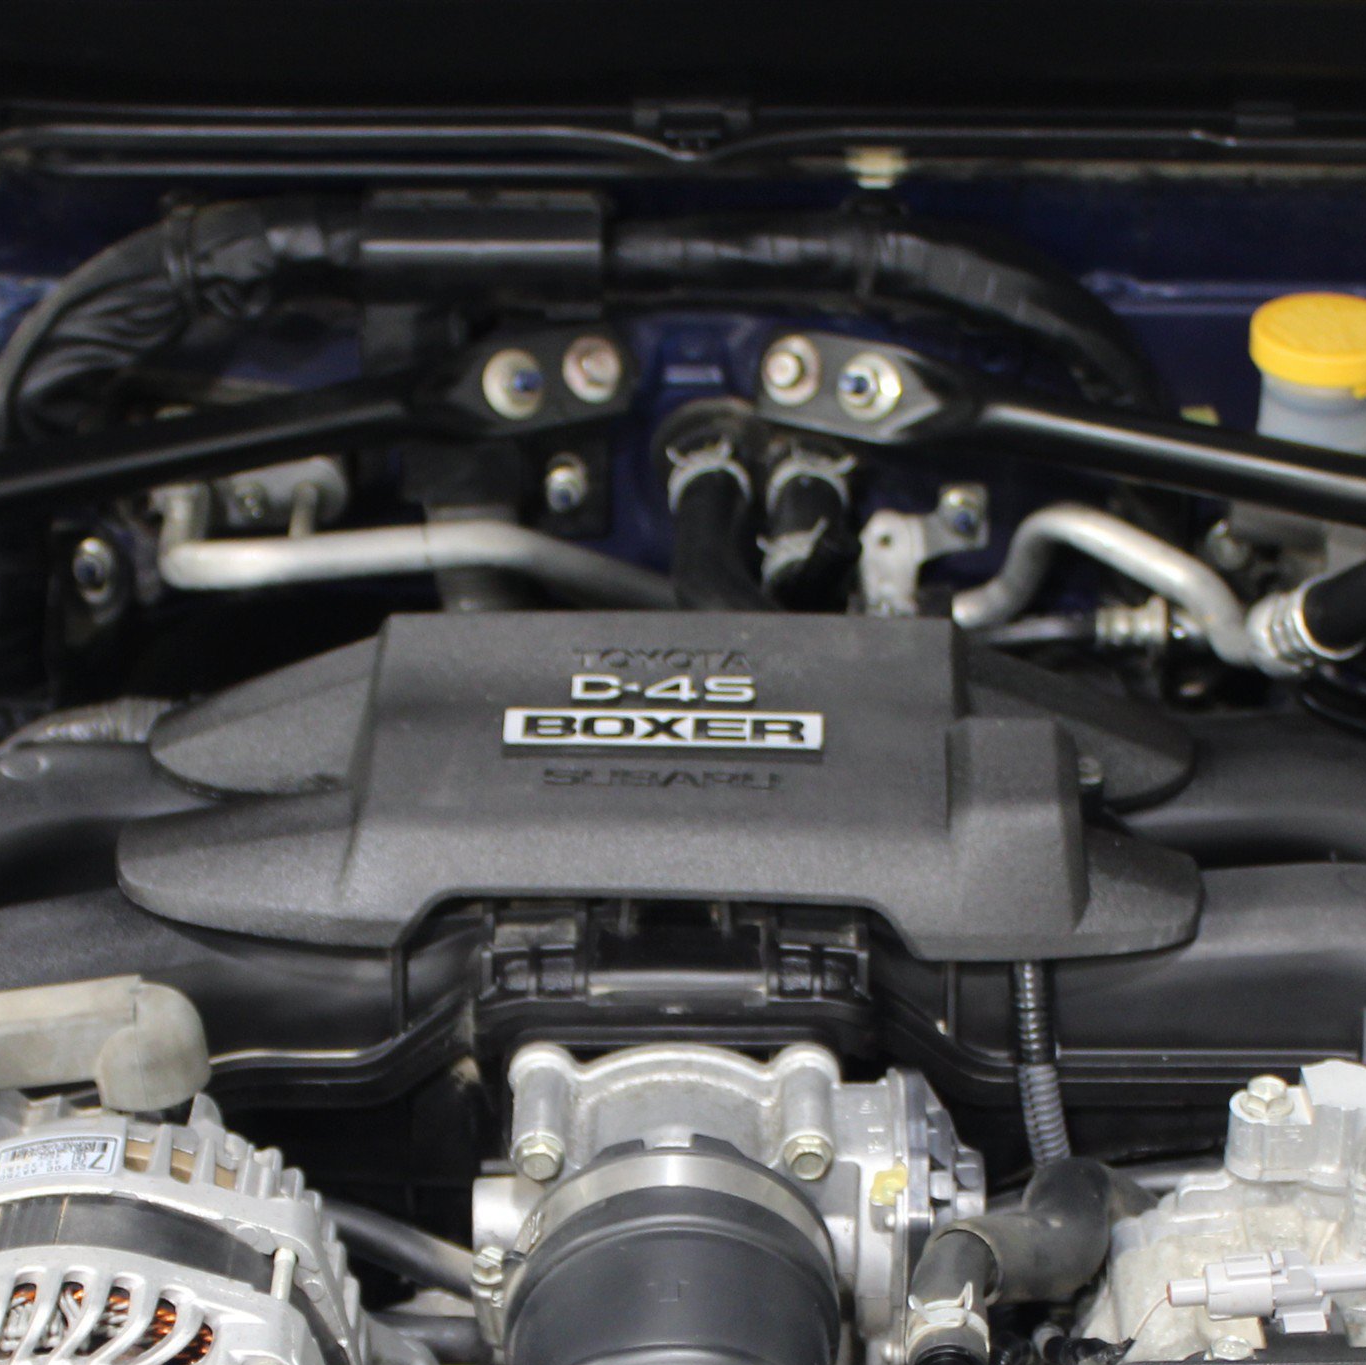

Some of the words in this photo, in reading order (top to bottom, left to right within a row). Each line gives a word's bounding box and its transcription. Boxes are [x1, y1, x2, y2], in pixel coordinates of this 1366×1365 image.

[572, 648, 751, 669] TOYOTA
[570, 673, 757, 702] D-4S
[522, 715, 807, 743] BOXER
[543, 768, 785, 791] SUBARU
